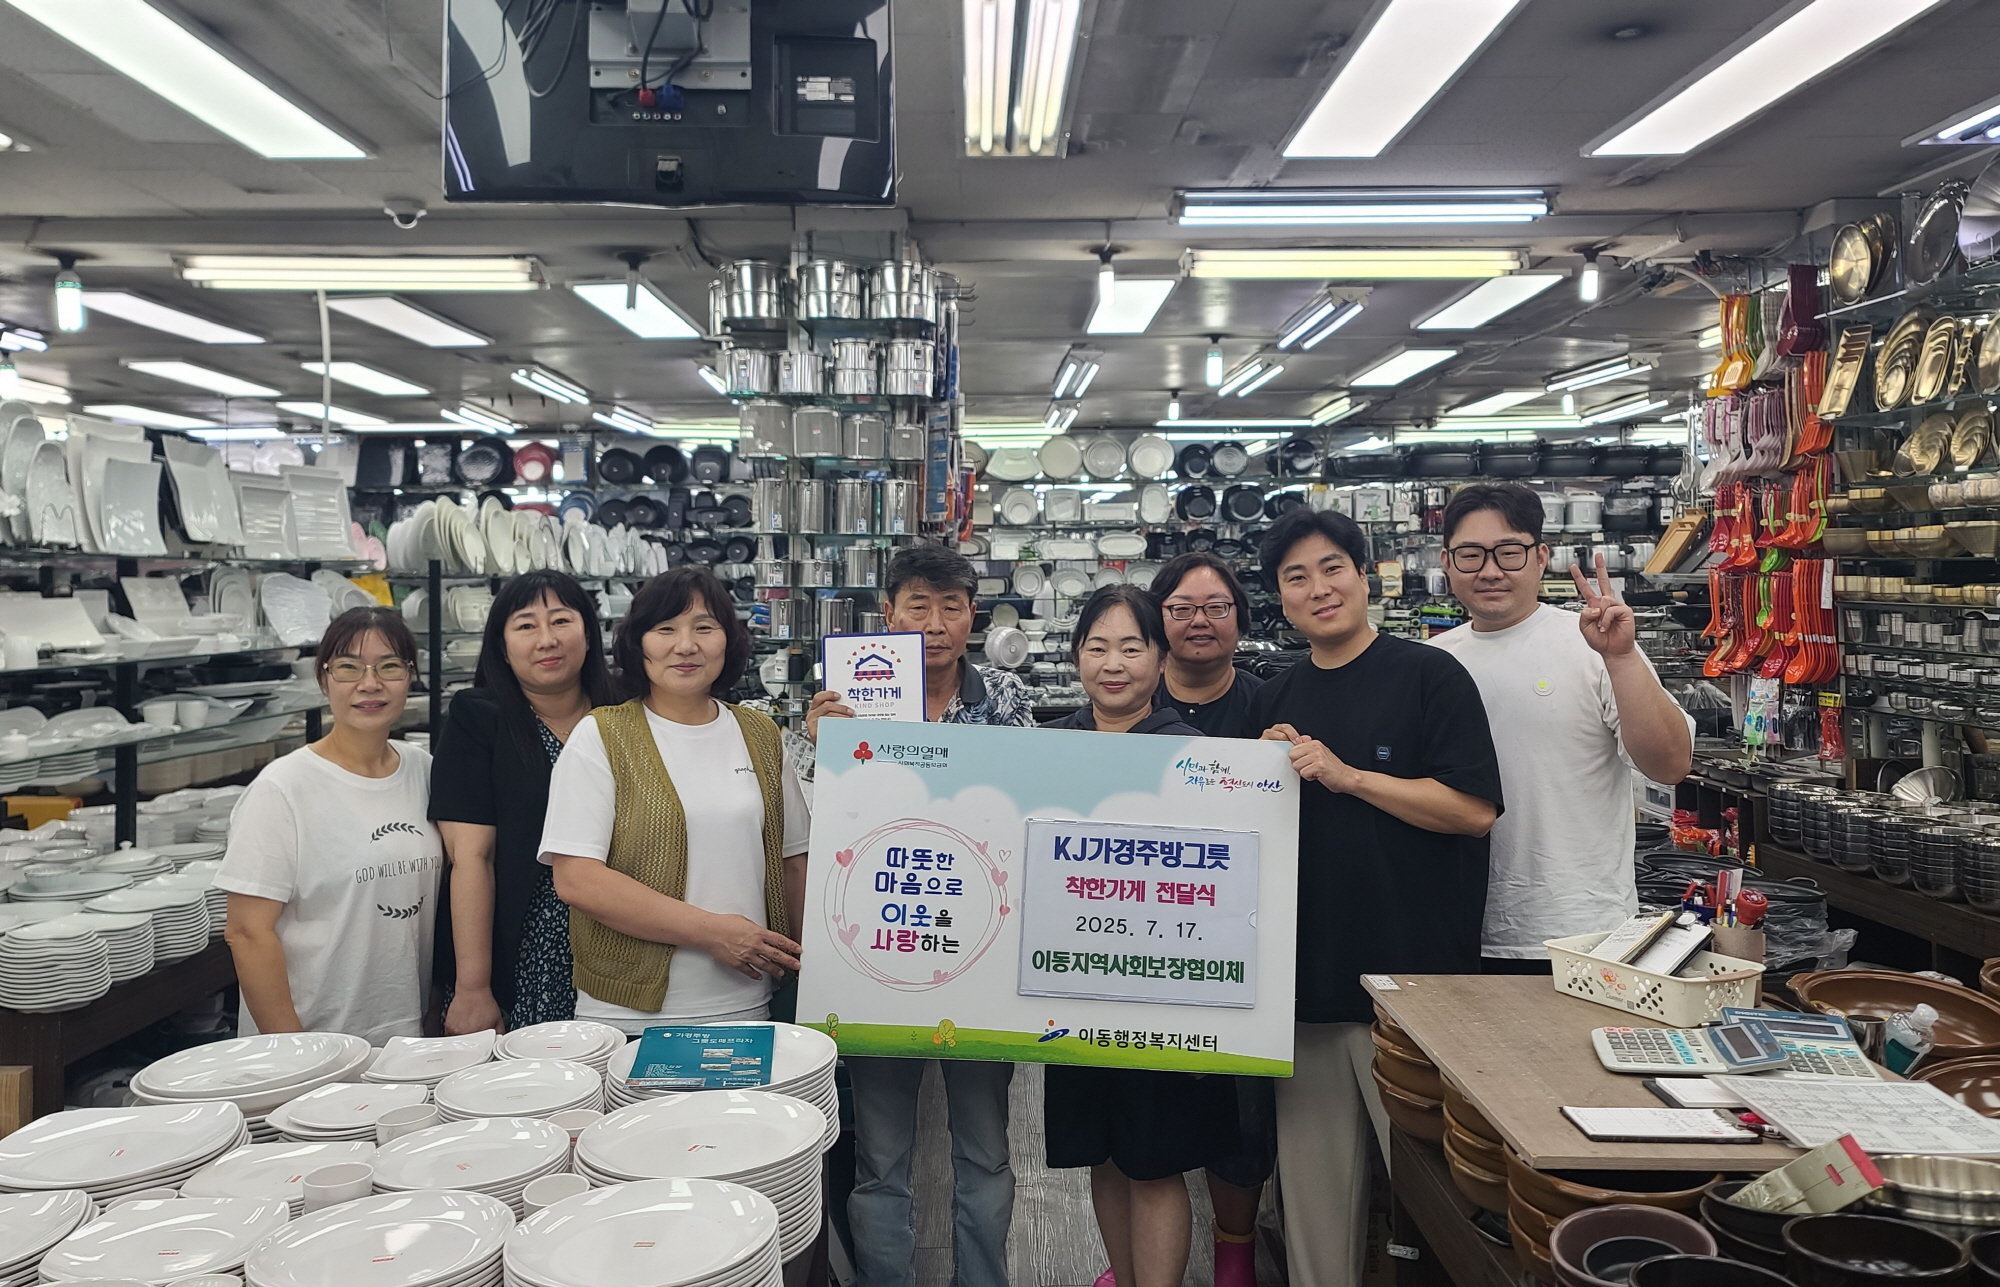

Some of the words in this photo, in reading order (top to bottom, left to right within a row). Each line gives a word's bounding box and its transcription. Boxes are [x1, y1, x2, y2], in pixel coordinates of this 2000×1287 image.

[847, 686, 902, 702] 착한가게
[875, 701, 895, 709] SHOP
[877, 744, 949, 760] 사랑의열매
[1175, 757, 1208, 776] 시민과
[1208, 760, 1231, 775] 함께,
[1185, 776, 1216, 792] 자유로운
[1219, 777, 1254, 793] 혁신도시
[1256, 779, 1285, 793] 안산
[886, 847, 955, 871] 따뜻한
[1054, 837, 1231, 870] KJ가경주방그릇
[355, 867, 375, 884] GOD
[377, 863, 396, 878] WILL
[397, 860, 408, 875] BE
[409, 857, 428, 873] WITH
[874, 871, 963, 897] 마음으로
[1065, 876, 1146, 903] 착한가게
[1155, 882, 1216, 907] 전달식
[881, 904, 953, 928] 이웃을
[1076, 916, 1134, 938] 2025.
[1146, 920, 1164, 938] 7.
[1176, 922, 1203, 941] 17.
[870, 930, 960, 953] 사랑하는
[1031, 951, 1245, 984] 이동지역사회보장협의체
[1078, 1026, 1218, 1052] 이동행정복지센터
